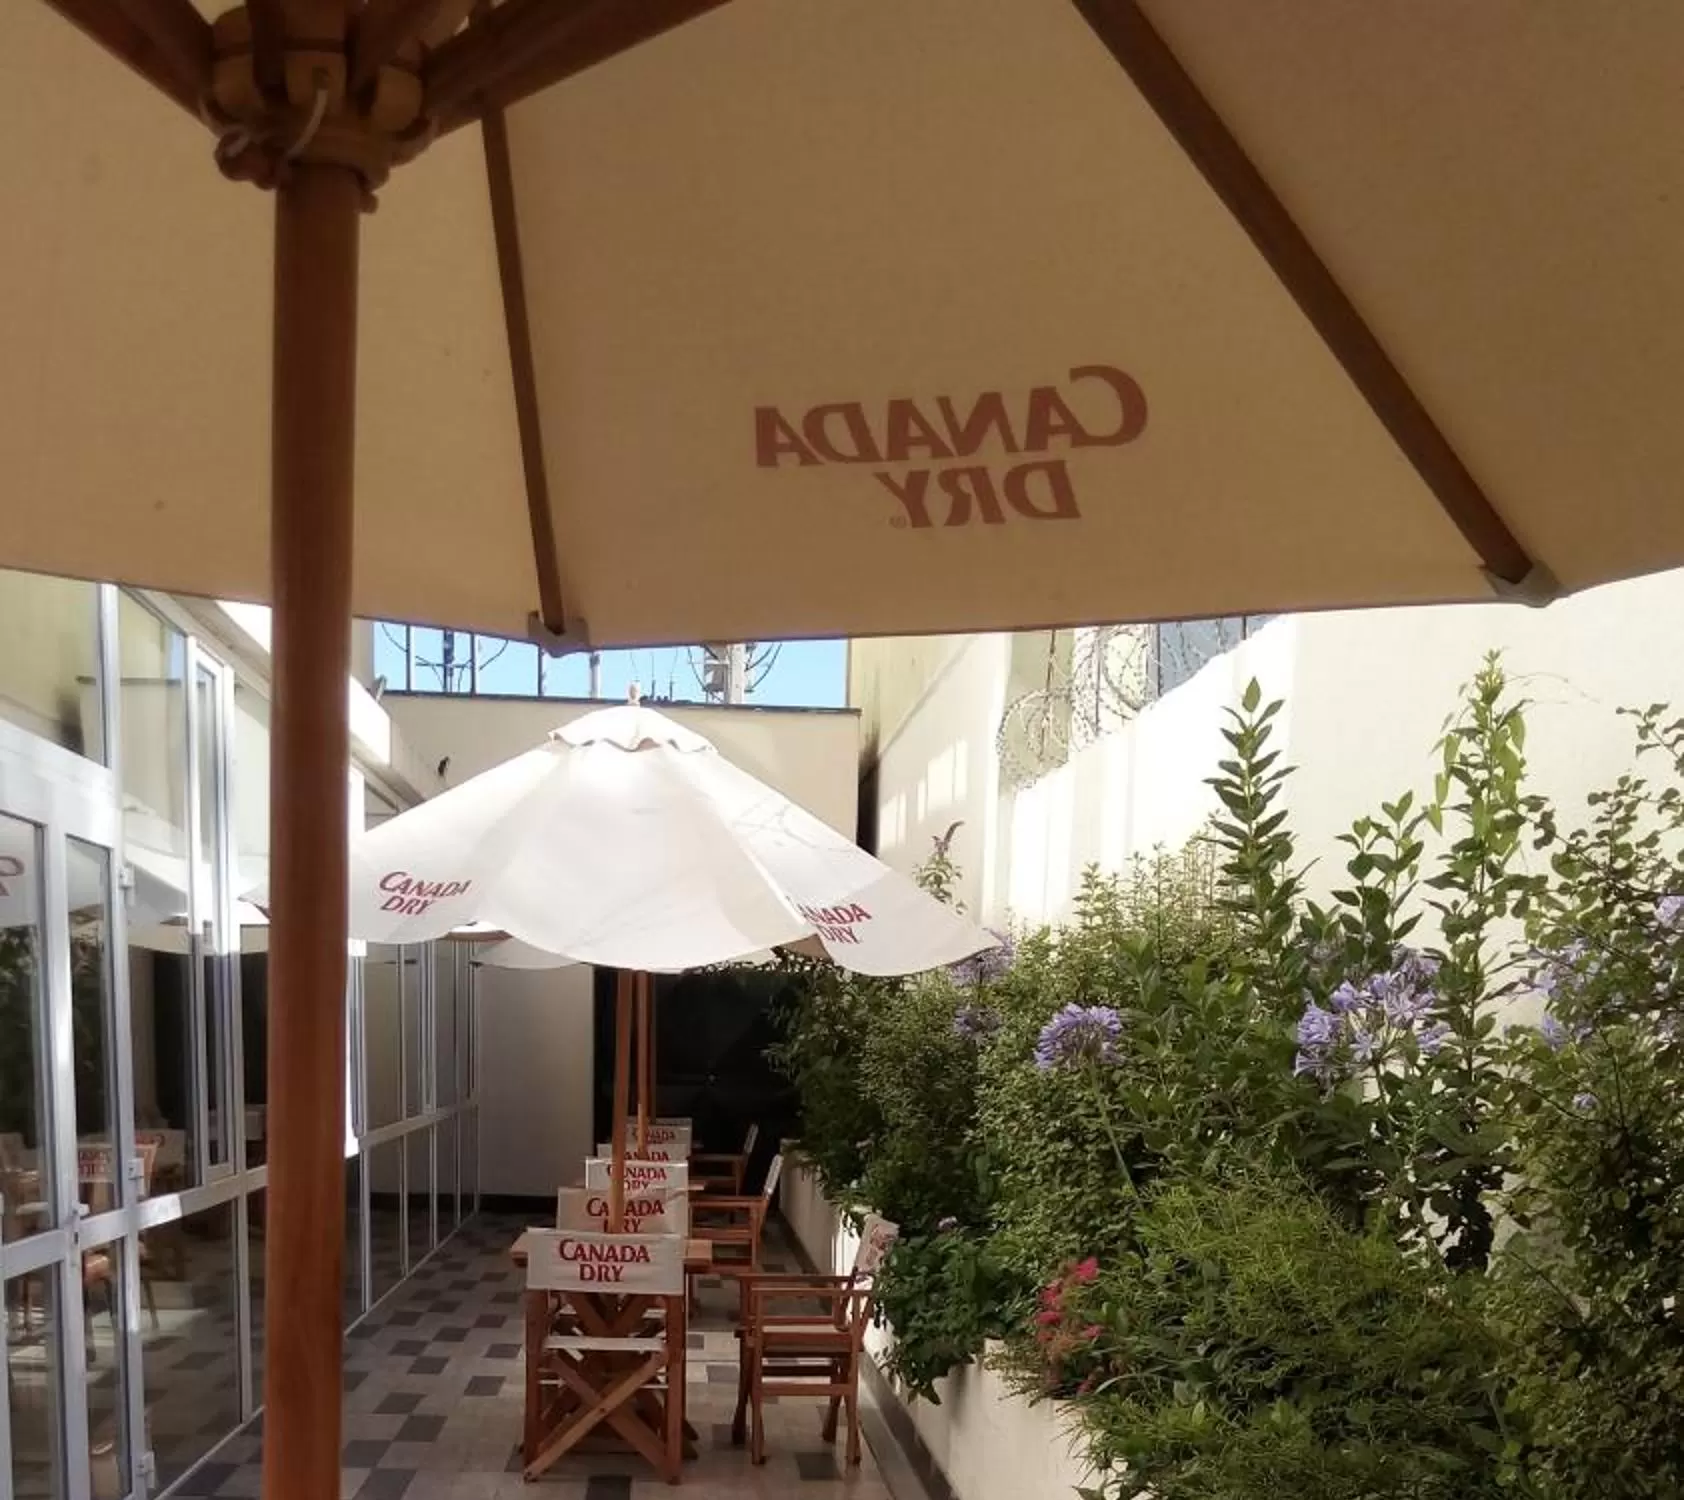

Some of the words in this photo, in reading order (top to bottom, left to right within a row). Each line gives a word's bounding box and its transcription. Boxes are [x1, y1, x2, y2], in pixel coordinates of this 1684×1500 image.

[379, 871, 472, 897] CANADA
[381, 895, 434, 915] DRY
[607, 1164, 667, 1180] NADA
[587, 1197, 665, 1217] CAADA
[559, 1239, 651, 1263] CANADA
[579, 1263, 624, 1283] DRY
